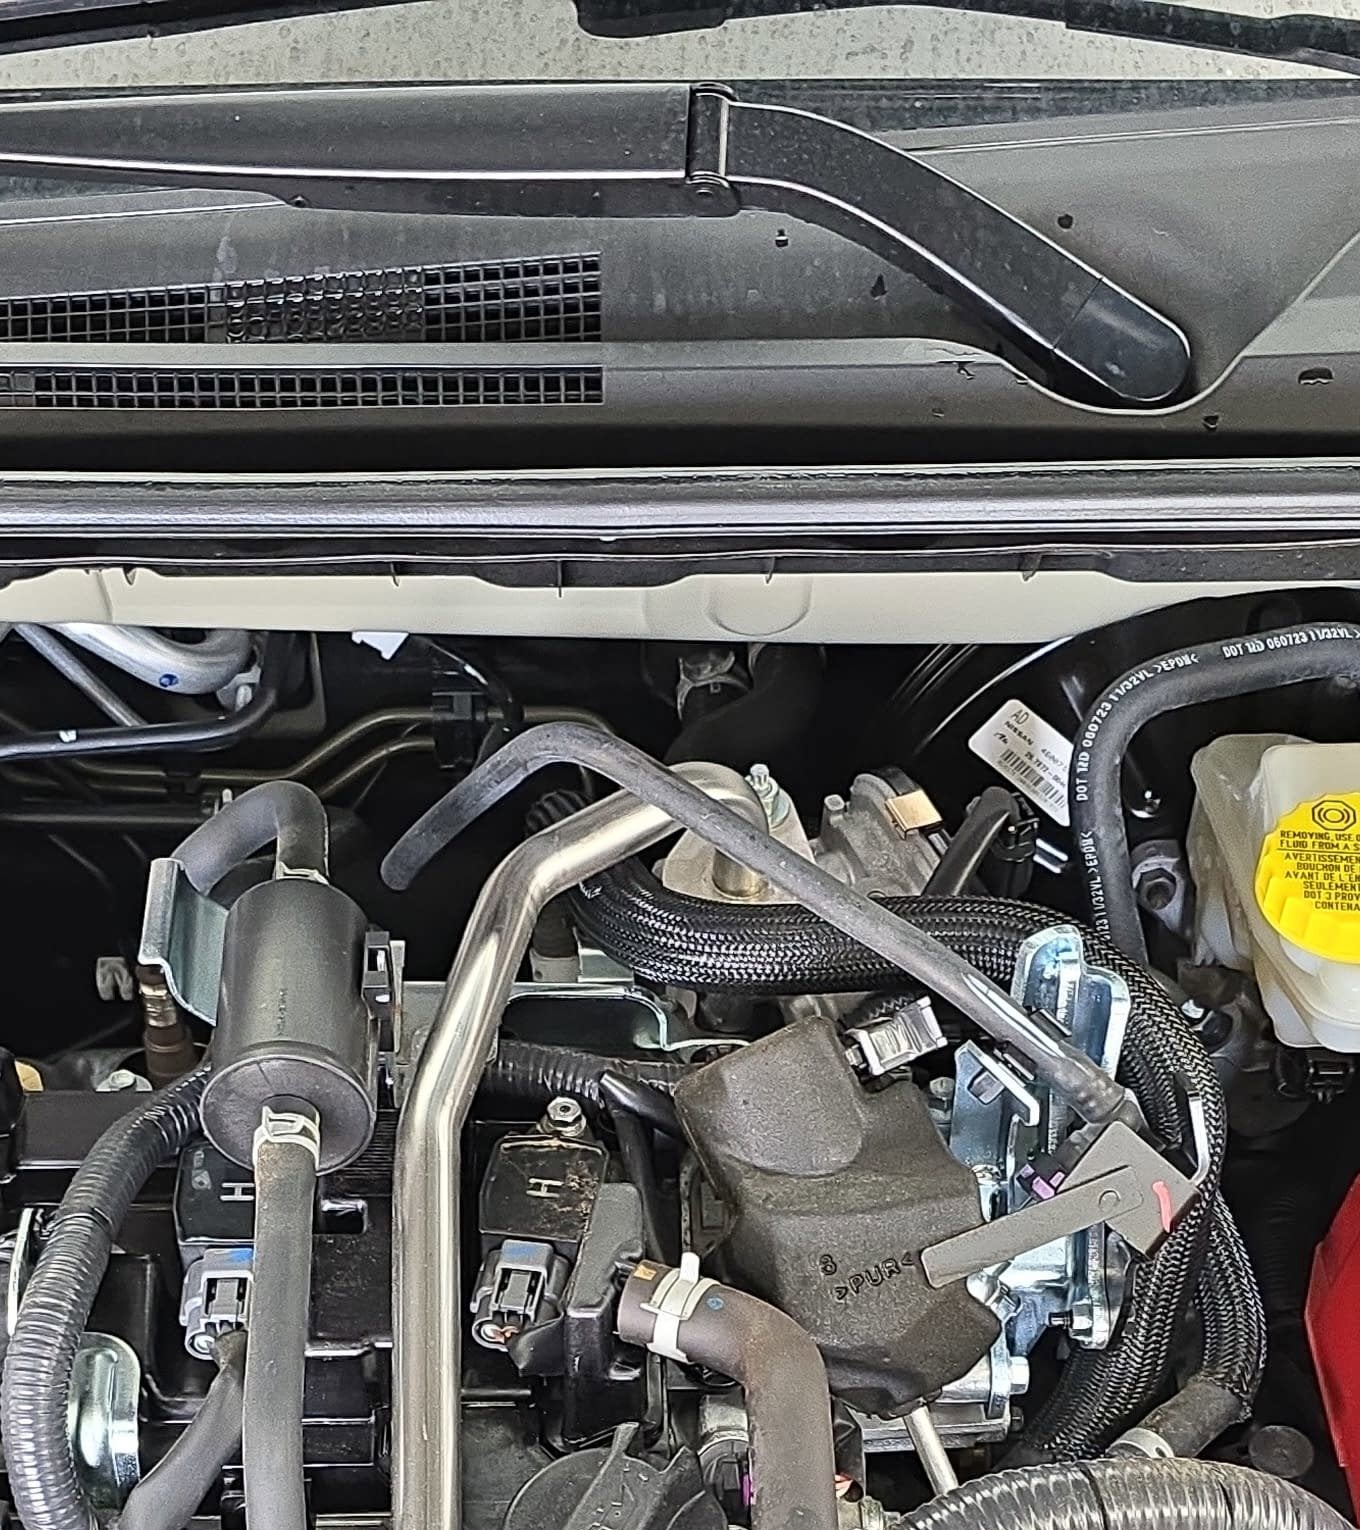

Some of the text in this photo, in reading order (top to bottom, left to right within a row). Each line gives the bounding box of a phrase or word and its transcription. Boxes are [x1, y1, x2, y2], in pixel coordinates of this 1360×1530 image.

[1222, 643, 1244, 658] DOT
[1004, 721, 1034, 746] NISSAN
[1075, 778, 1089, 801] DOT
[1335, 833, 1353, 842] USE
[1280, 839, 1308, 849] FLUID
[1311, 840, 1340, 850] FROM
[1343, 841, 1351, 850] A
[1296, 861, 1341, 872] BOUCHON
[1343, 863, 1355, 873] DE
[1284, 871, 1320, 880] AVANT
[1323, 872, 1336, 881] DE
[1303, 890, 1322, 899] DOT
[1324, 891, 1332, 900] 3
